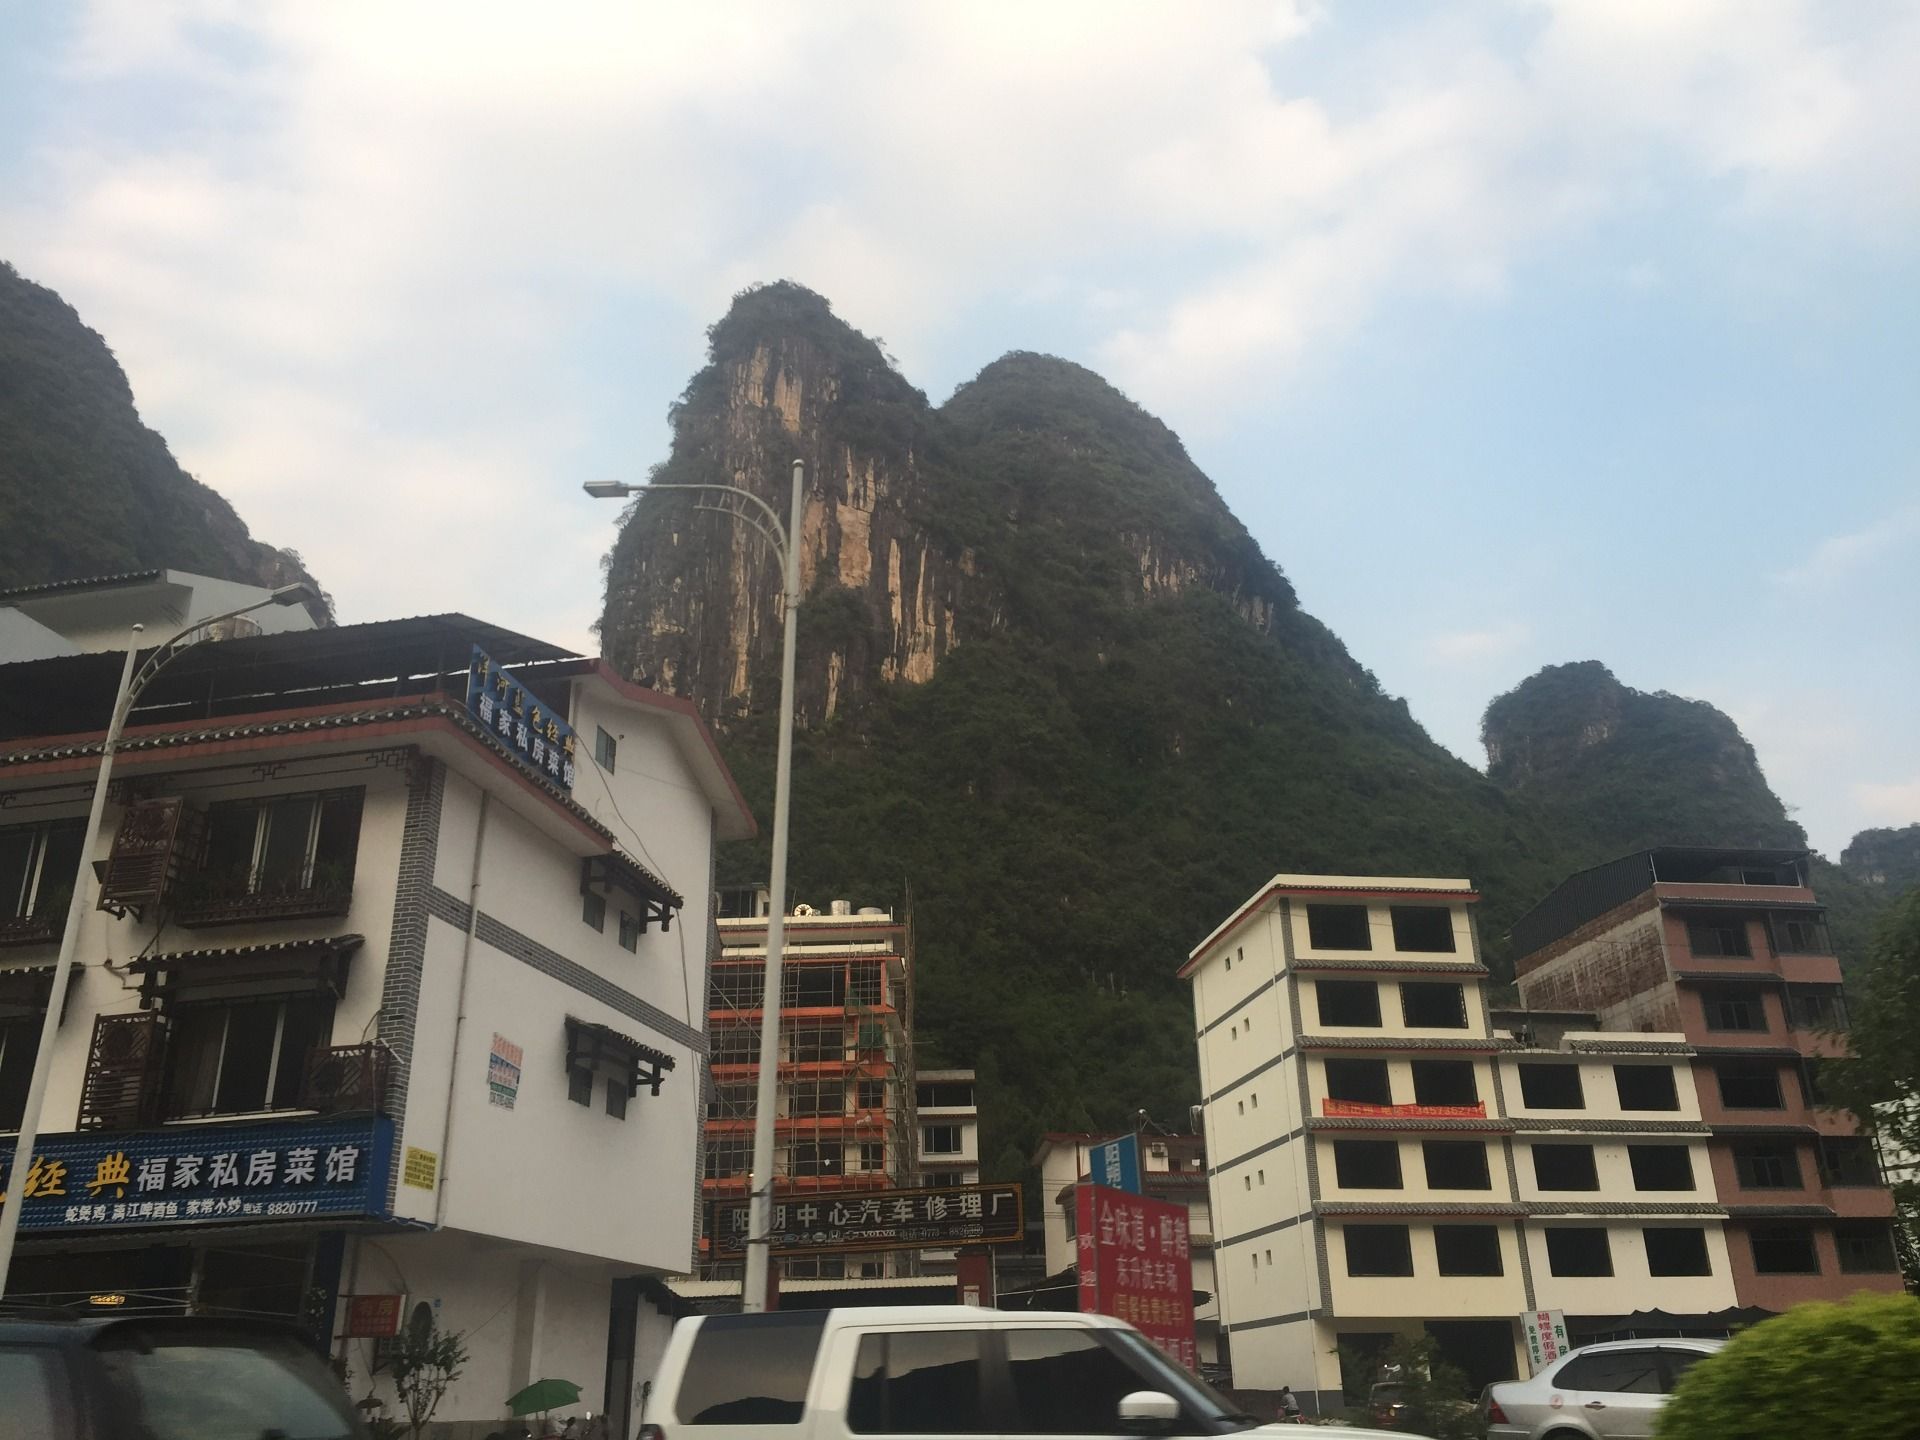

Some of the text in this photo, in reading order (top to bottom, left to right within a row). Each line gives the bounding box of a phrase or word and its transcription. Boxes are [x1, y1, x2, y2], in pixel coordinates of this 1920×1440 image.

[479, 693, 575, 788] 福家私房菜馆
[137, 1145, 359, 1192] 福家私房菜馆
[186, 1198, 241, 1217] 家常小炒
[243, 1203, 262, 1215] 电话
[267, 1200, 318, 1217] 8820777
[1079, 1232, 1096, 1314] 欢迎
[1537, 1312, 1557, 1366] 蝴蝶度假酒
